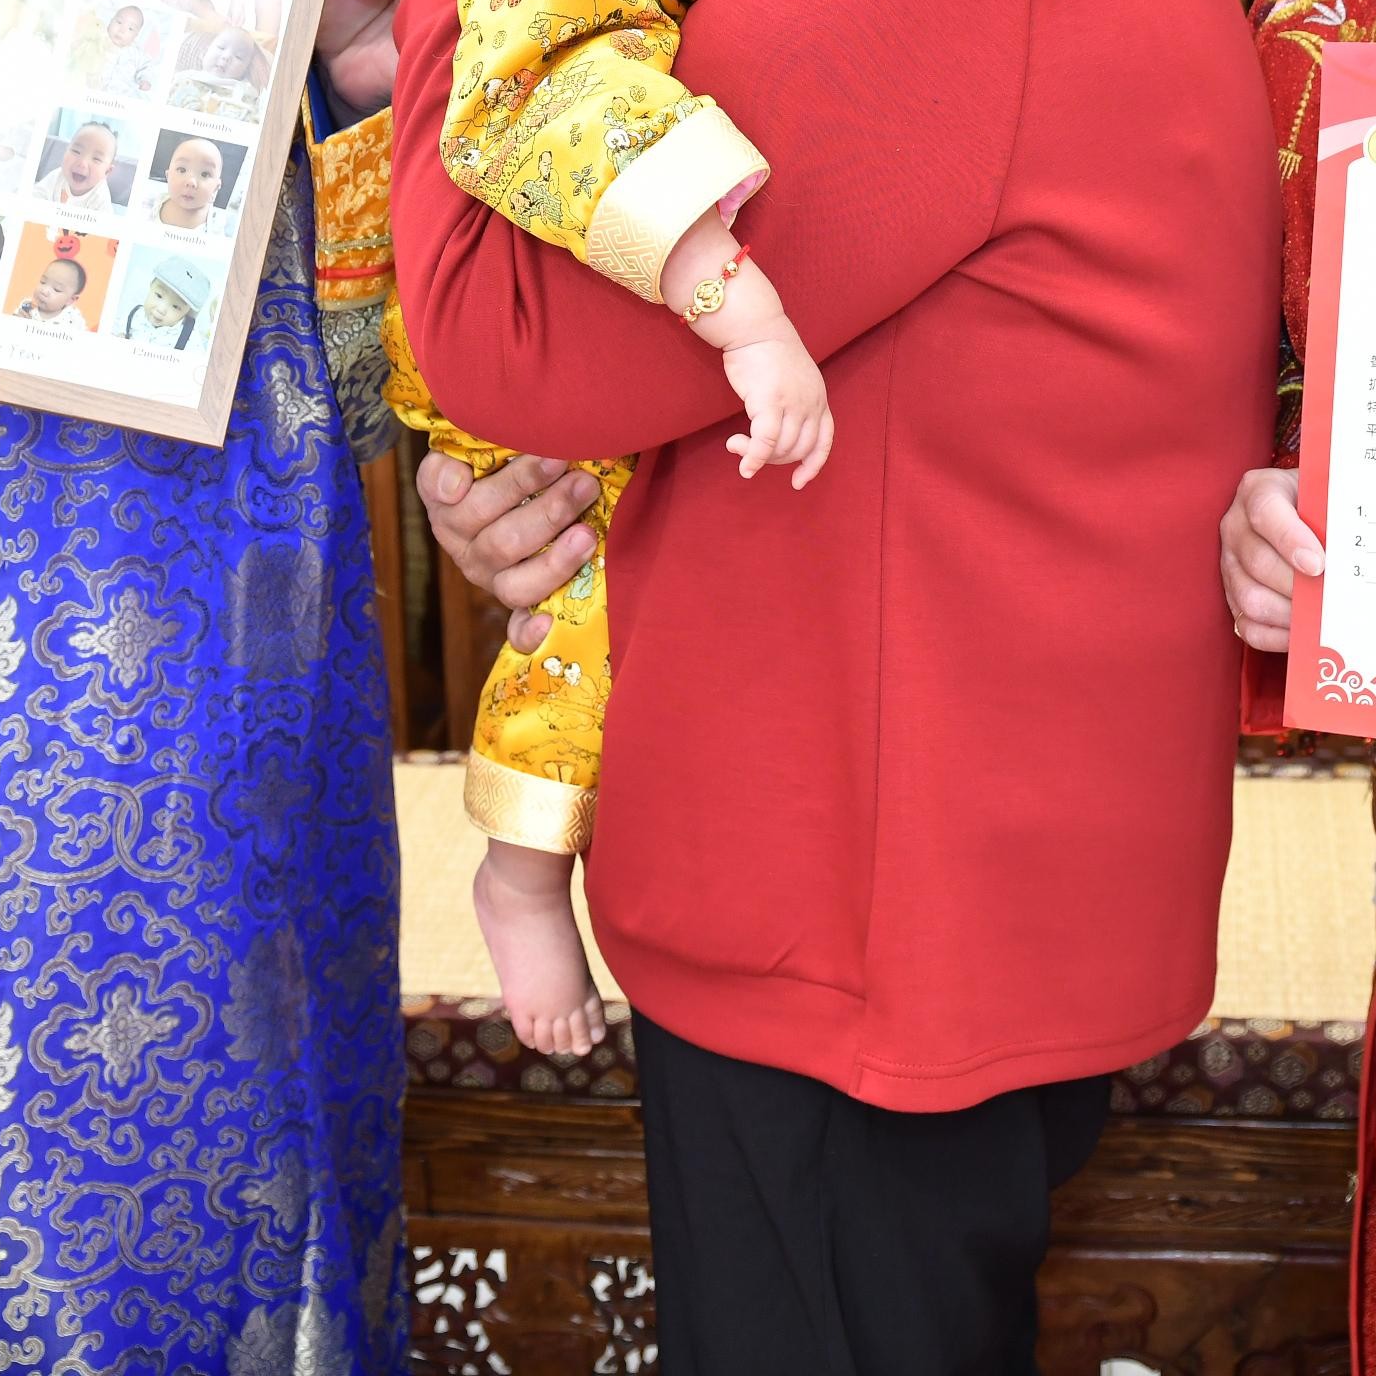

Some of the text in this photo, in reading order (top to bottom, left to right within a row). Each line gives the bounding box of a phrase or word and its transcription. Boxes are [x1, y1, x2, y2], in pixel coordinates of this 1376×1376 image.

[55, 206, 99, 224] 7months
[163, 229, 208, 247] 8months
[25, 324, 74, 343] 11months
[8, 343, 45, 362] Year
[1356, 505, 1367, 518] 1.
[1355, 535, 1366, 548] 2.
[1353, 565, 1365, 578] 3.
